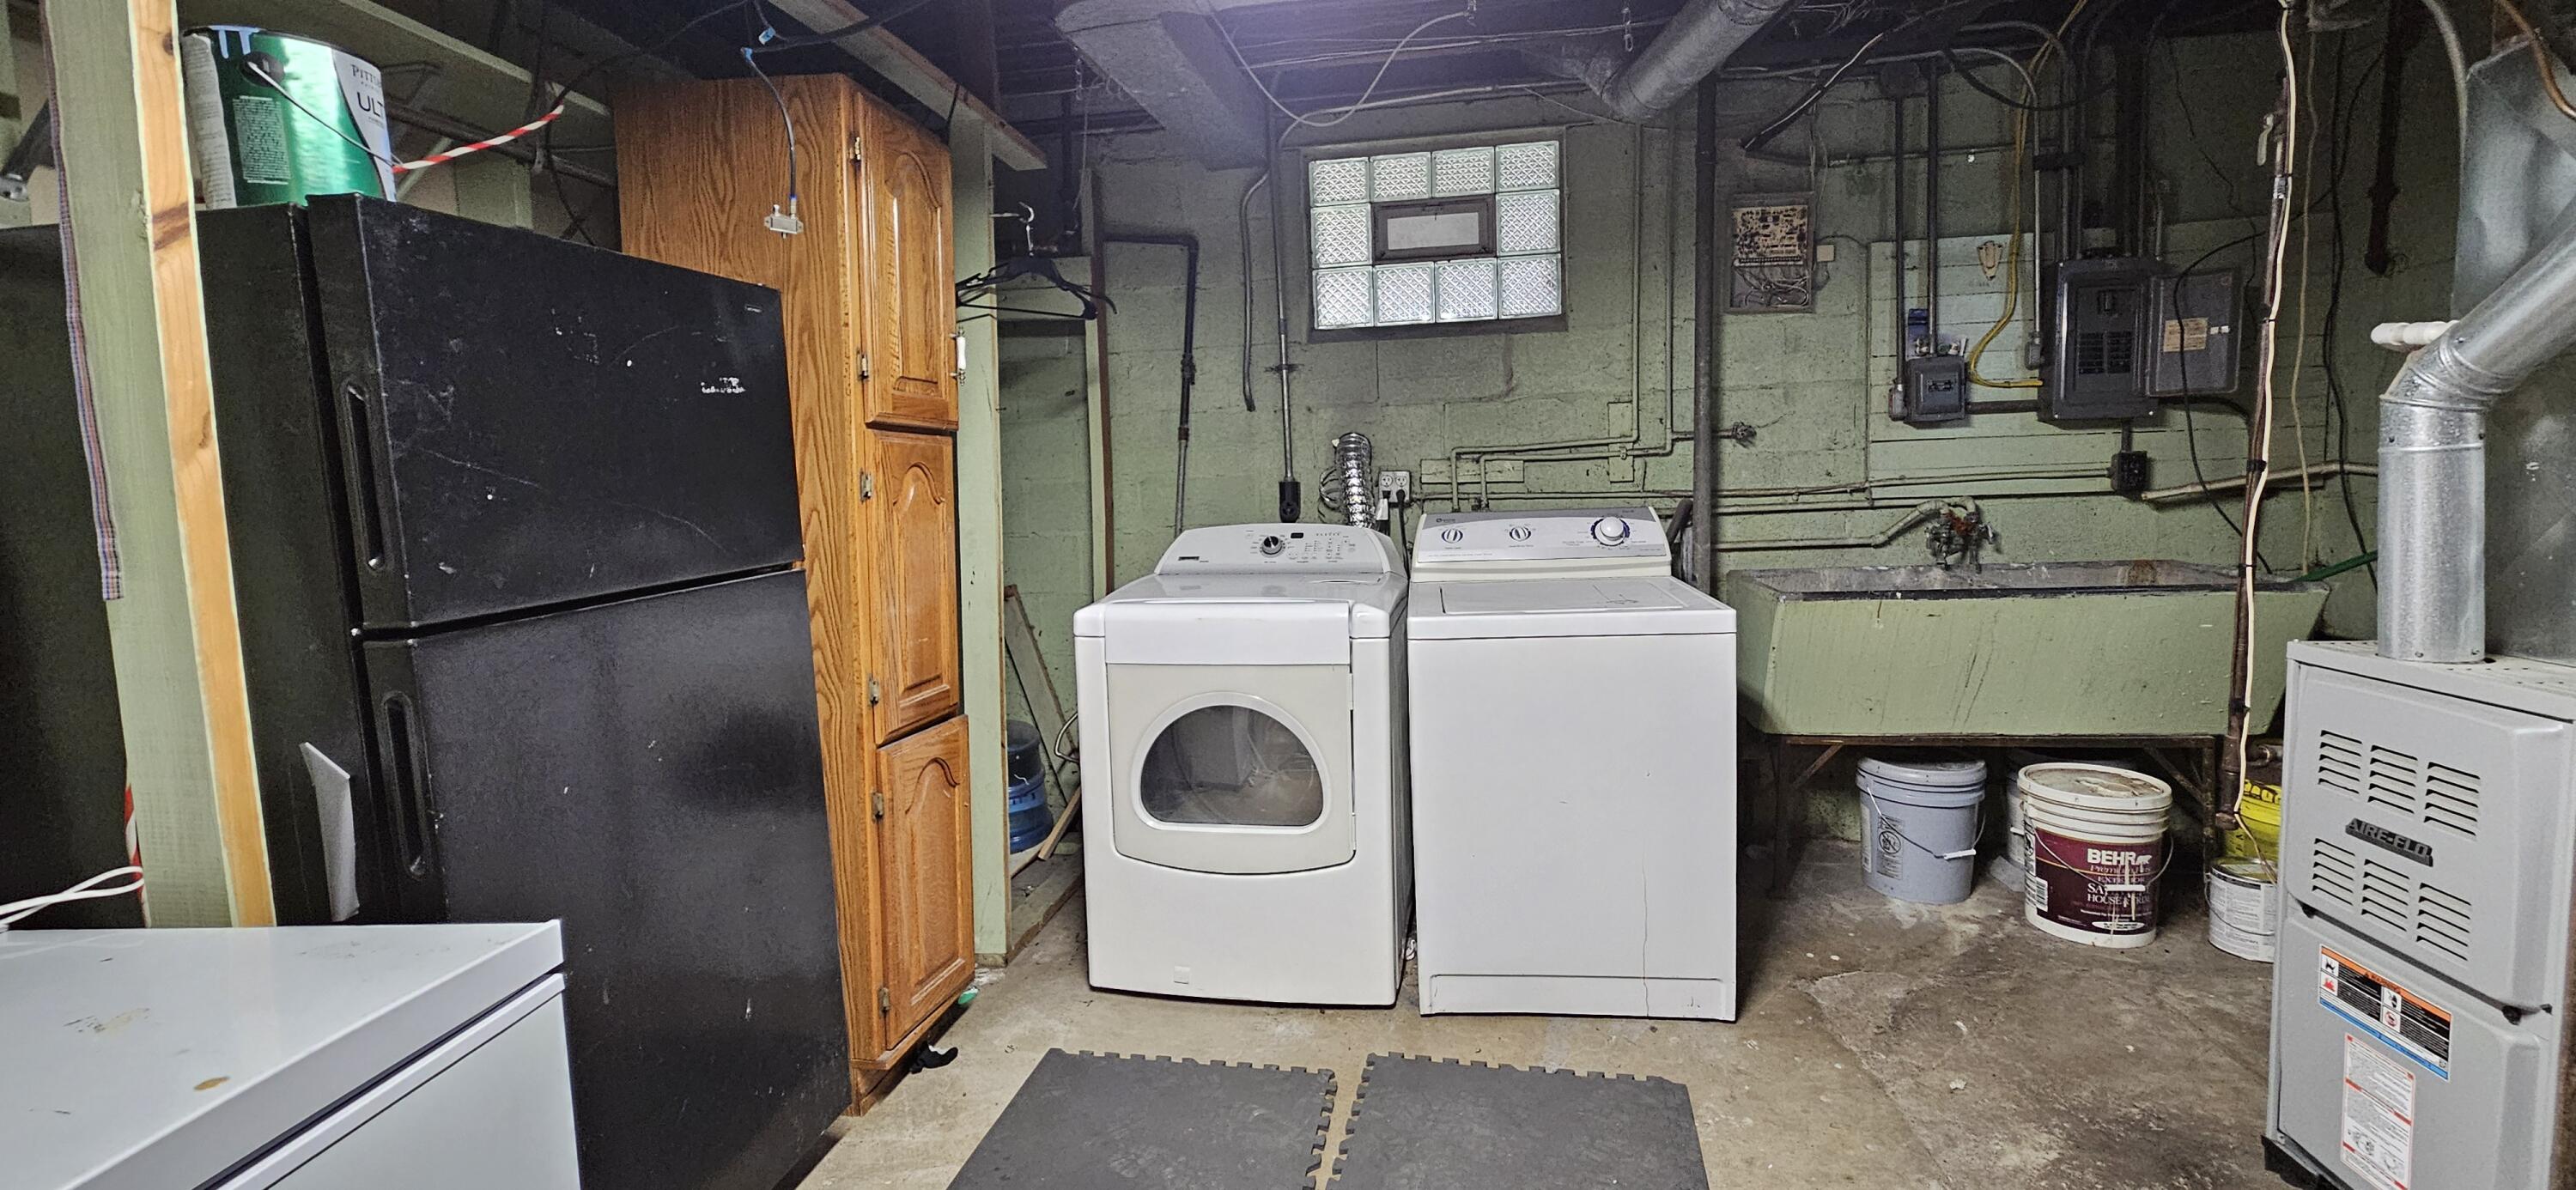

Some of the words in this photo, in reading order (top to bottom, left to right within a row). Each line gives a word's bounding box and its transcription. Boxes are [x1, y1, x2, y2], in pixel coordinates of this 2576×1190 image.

[2348, 818, 2429, 858] AIRE-FLO
[2087, 848, 2136, 865] BEHR
[2087, 893, 2123, 905] HOUSE
